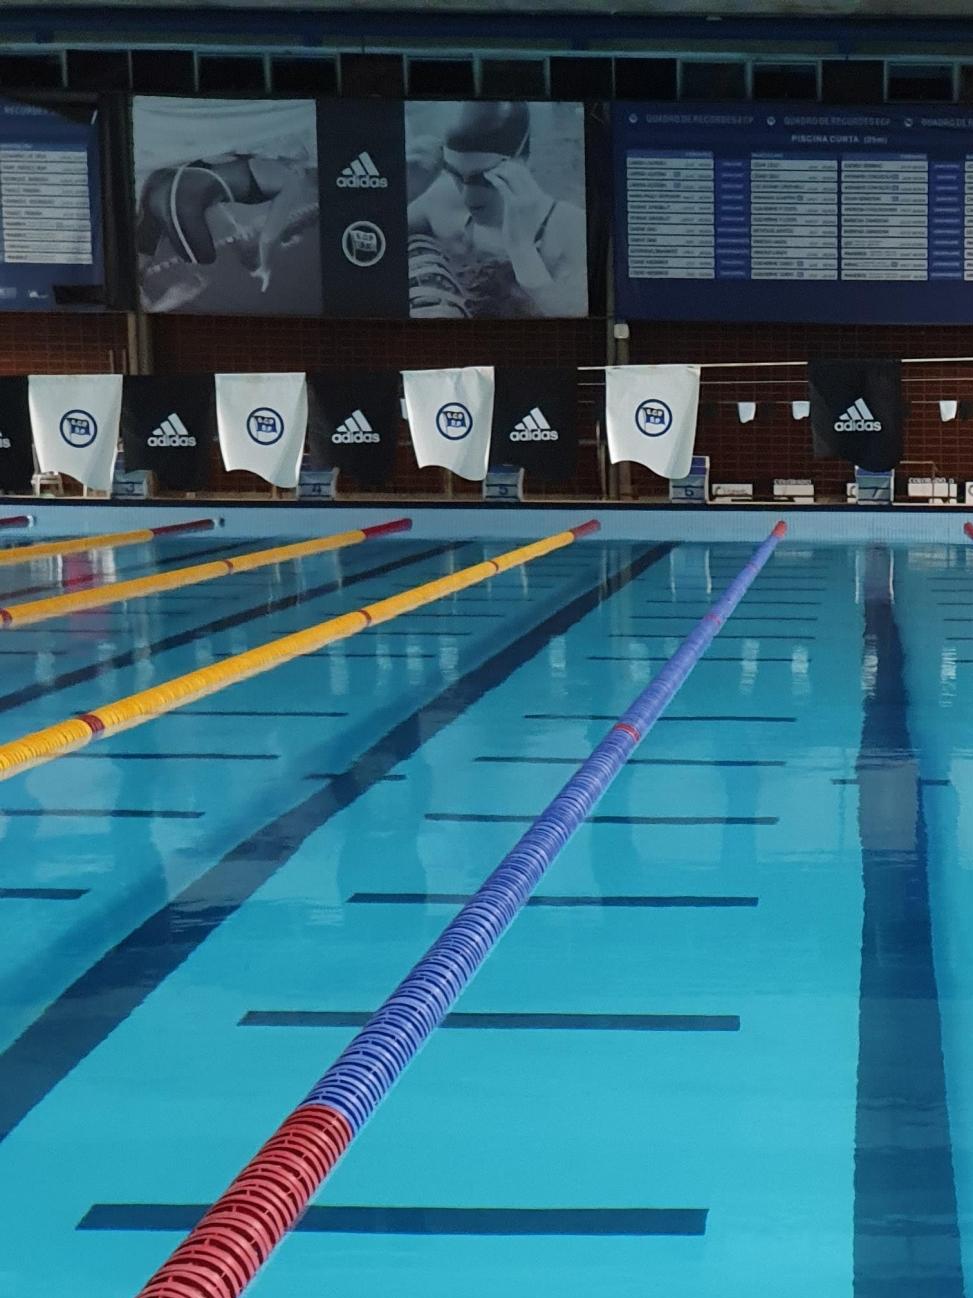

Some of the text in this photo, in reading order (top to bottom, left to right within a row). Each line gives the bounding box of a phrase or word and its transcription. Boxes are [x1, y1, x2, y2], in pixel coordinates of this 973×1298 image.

[791, 134, 828, 143] PISCINA
[336, 174, 388, 188] adidas
[834, 419, 882, 432] adidas
[148, 434, 197, 447] adidas
[332, 430, 381, 444] adidas
[510, 428, 559, 442] adidas
